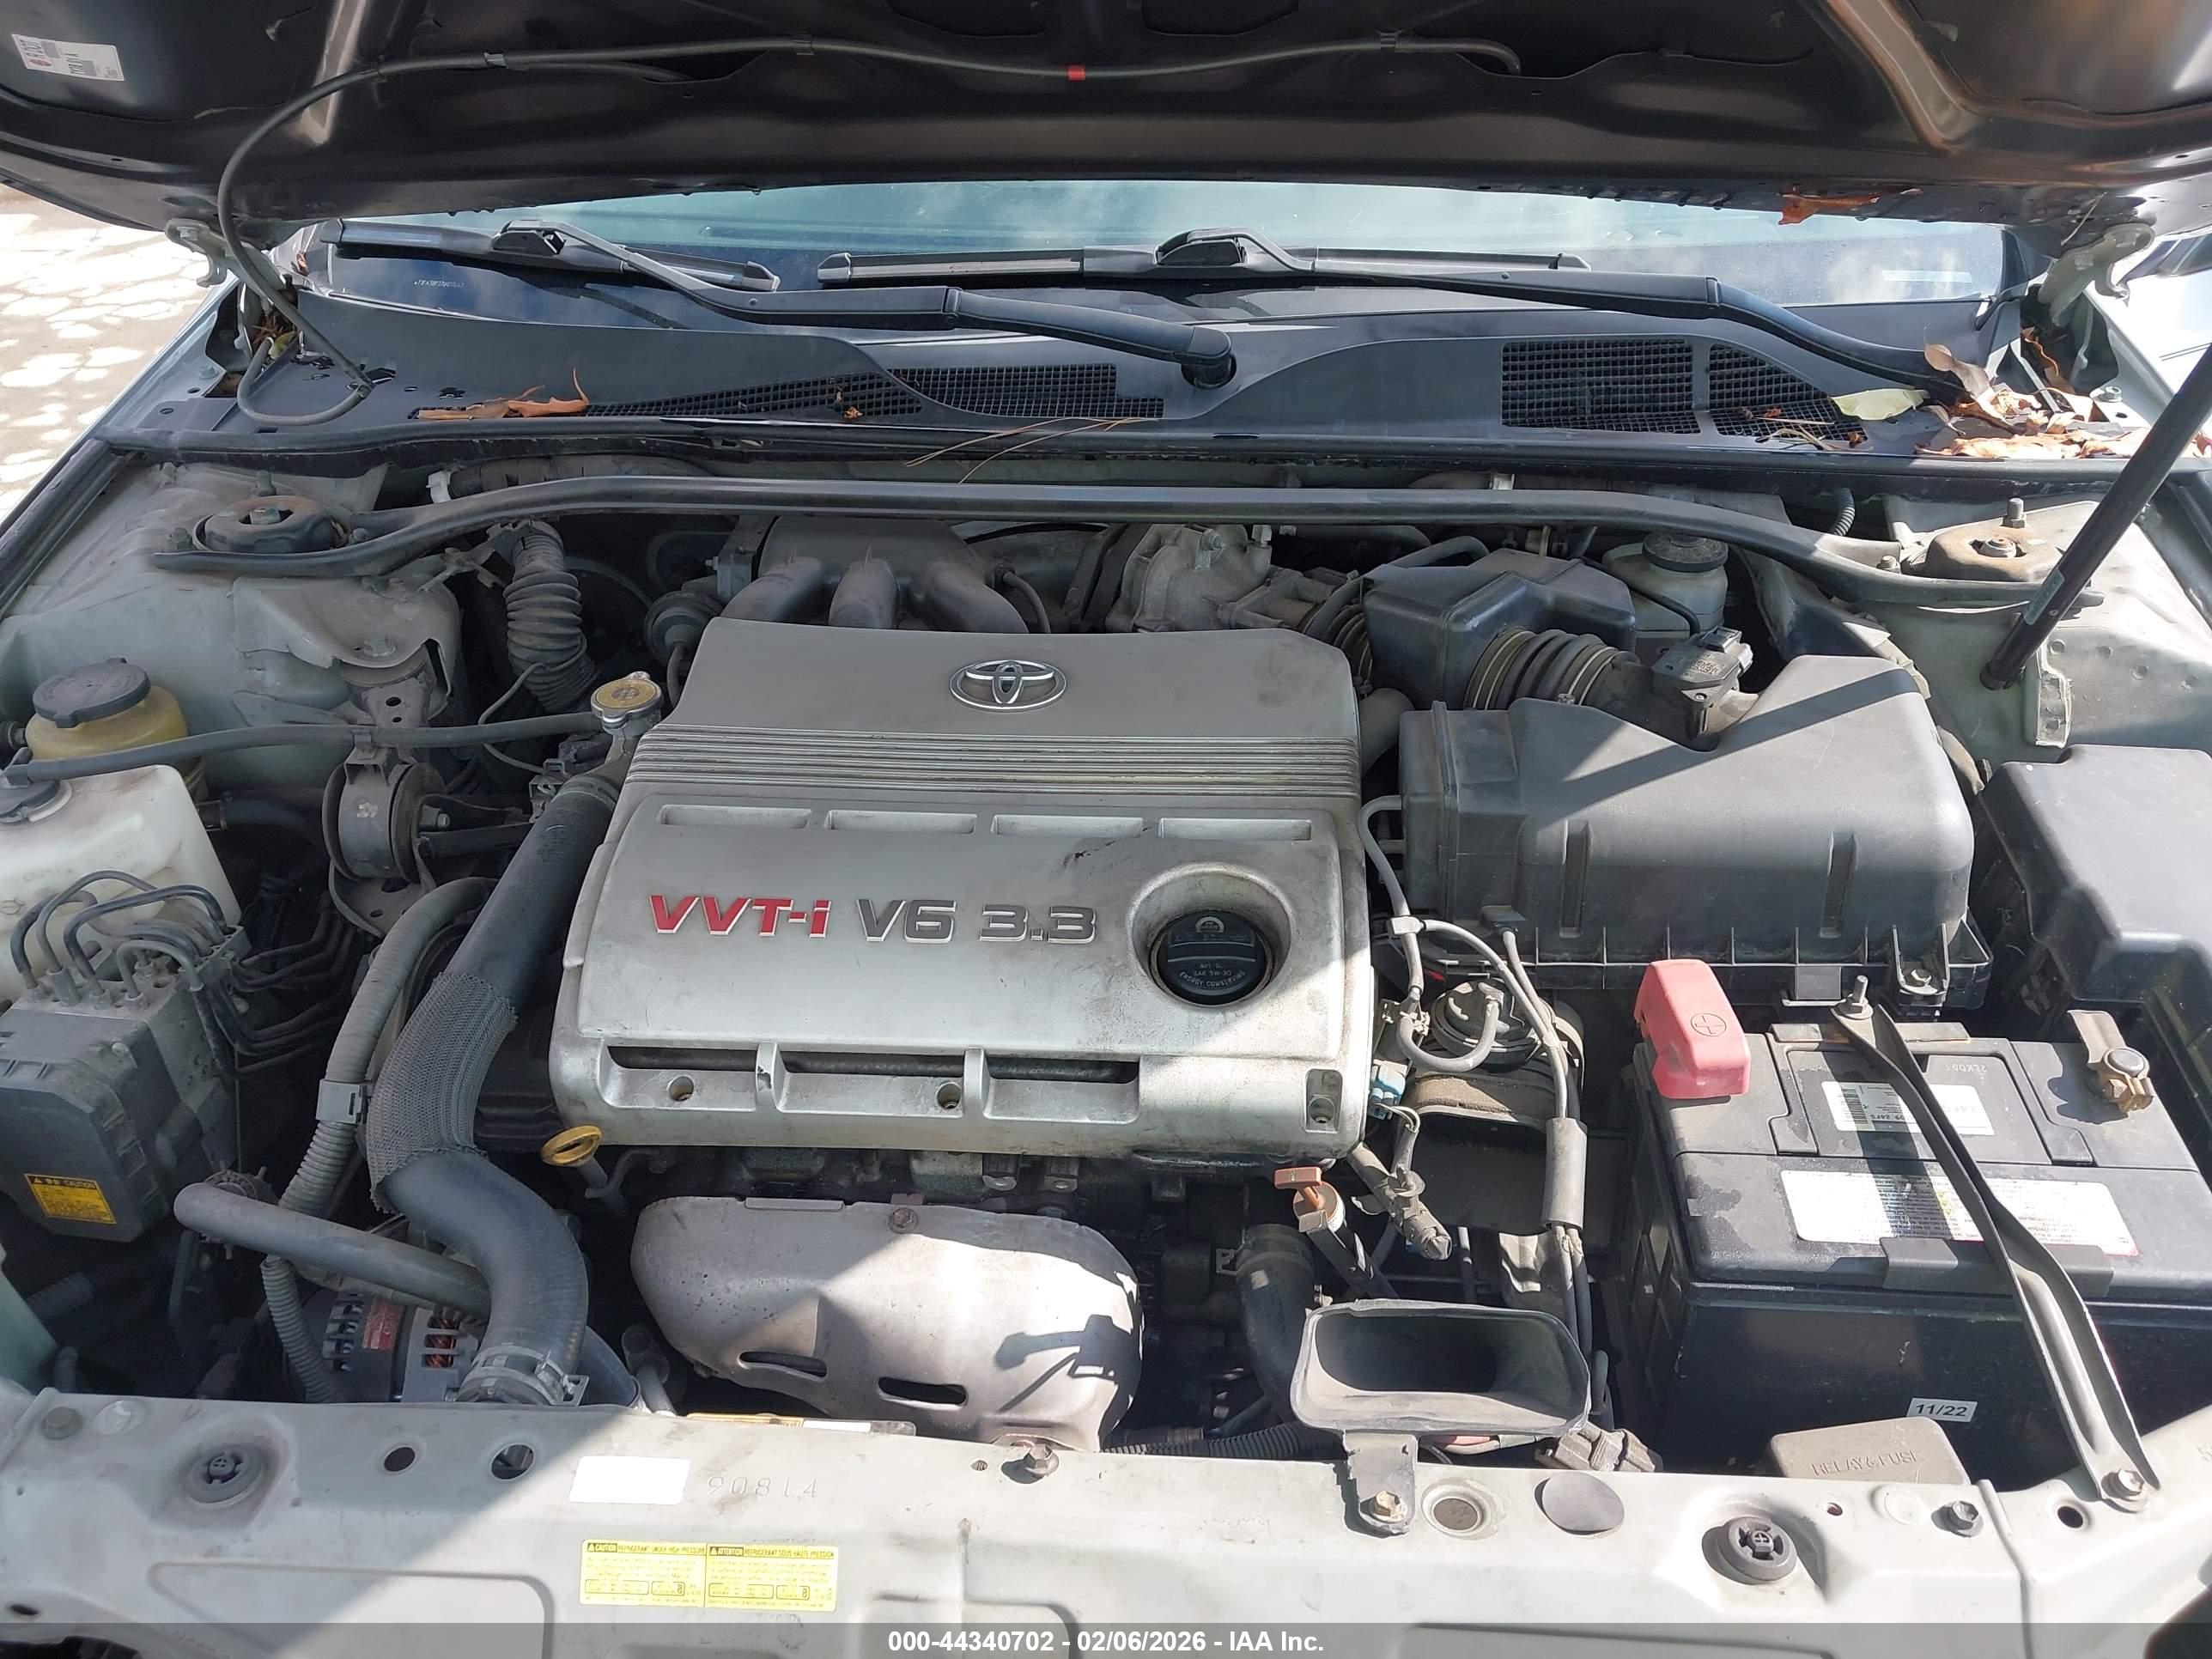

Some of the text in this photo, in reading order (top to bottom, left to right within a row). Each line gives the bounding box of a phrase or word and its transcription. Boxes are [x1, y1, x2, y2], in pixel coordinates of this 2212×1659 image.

[649, 895, 1097, 944] VVT-i V6 3.3
[1917, 1404, 1968, 1417] 11/22
